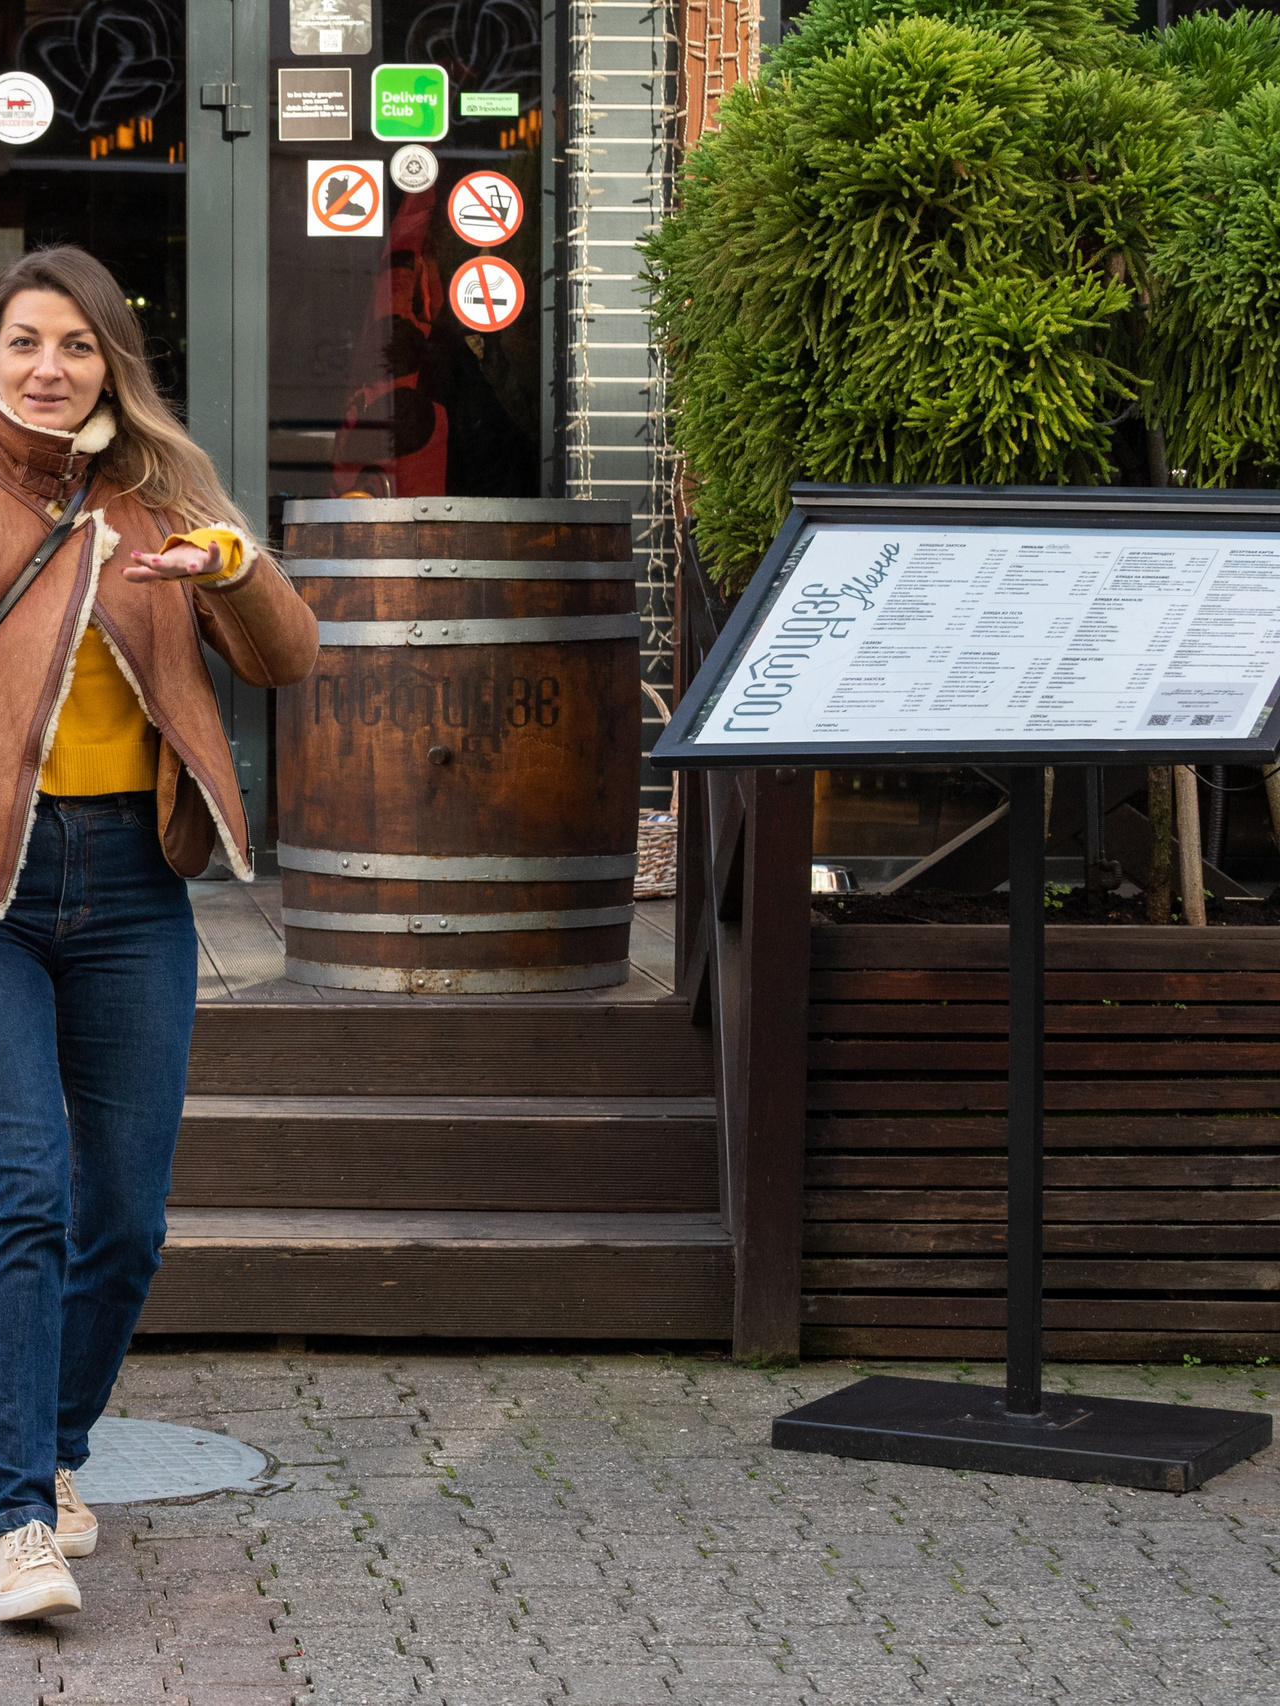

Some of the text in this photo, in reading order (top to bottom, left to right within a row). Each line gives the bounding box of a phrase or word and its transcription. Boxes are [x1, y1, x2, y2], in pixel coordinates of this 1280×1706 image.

[381, 91, 438, 106] Delivery
[381, 104, 414, 116] Club
[840, 542, 900, 610] Меню
